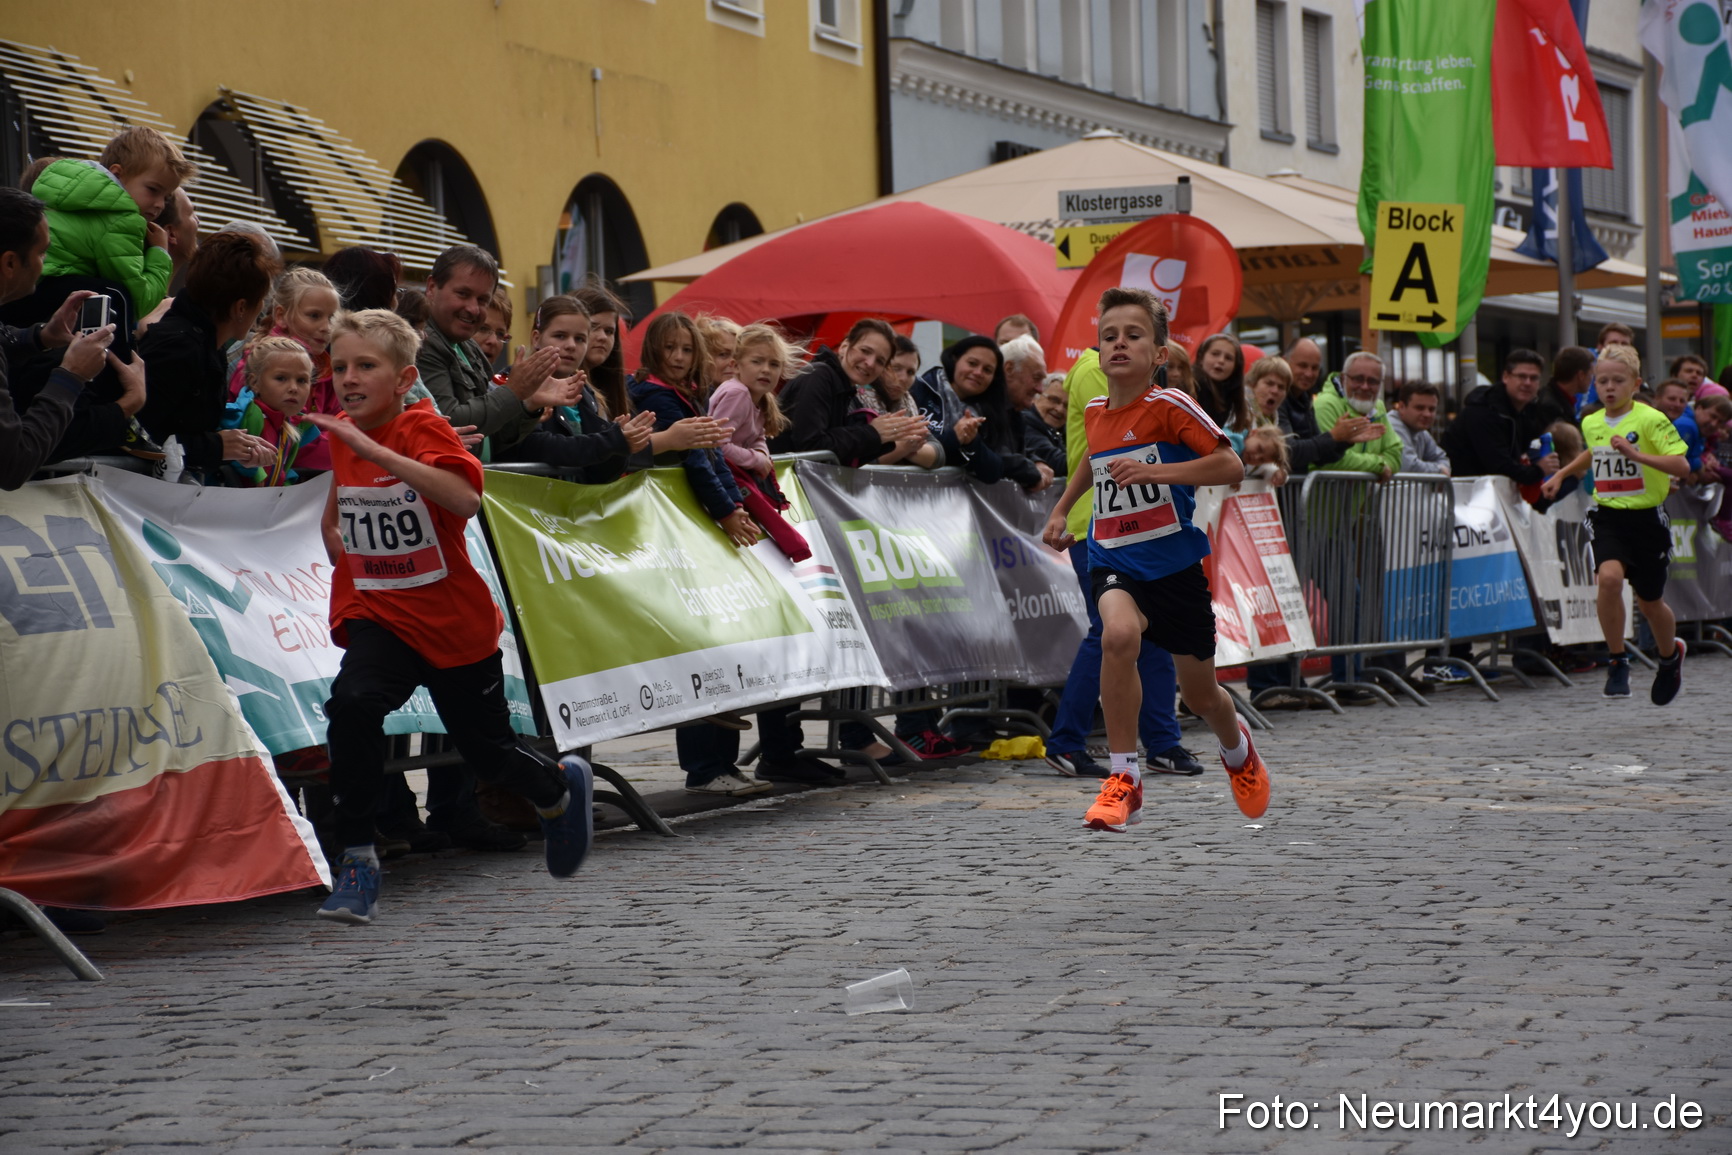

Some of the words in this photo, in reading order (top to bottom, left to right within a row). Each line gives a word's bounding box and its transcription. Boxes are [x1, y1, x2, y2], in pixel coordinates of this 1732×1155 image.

[1436, 54, 1476, 70] leben.
[1066, 194, 1163, 214] Klostergasse
[1388, 207, 1455, 233] Block
[1389, 242, 1440, 304] A
[1595, 458, 1638, 478] 7145
[360, 496, 403, 508] Neumarkt
[341, 509, 423, 550] 7169
[1118, 520, 1140, 534] Jan
[532, 527, 629, 585] Neue
[845, 528, 957, 583] BOCK
[363, 557, 416, 576] Walfried
[670, 570, 770, 623] langgeht!
[1449, 583, 1482, 610] ECKE
[1483, 577, 1528, 607] ZUHAUSE
[705, 683, 731, 697] Parkplätze
[571, 693, 613, 712] Dammstraße
[612, 691, 619, 703] 1
[575, 710, 608, 728] Neumarkt
